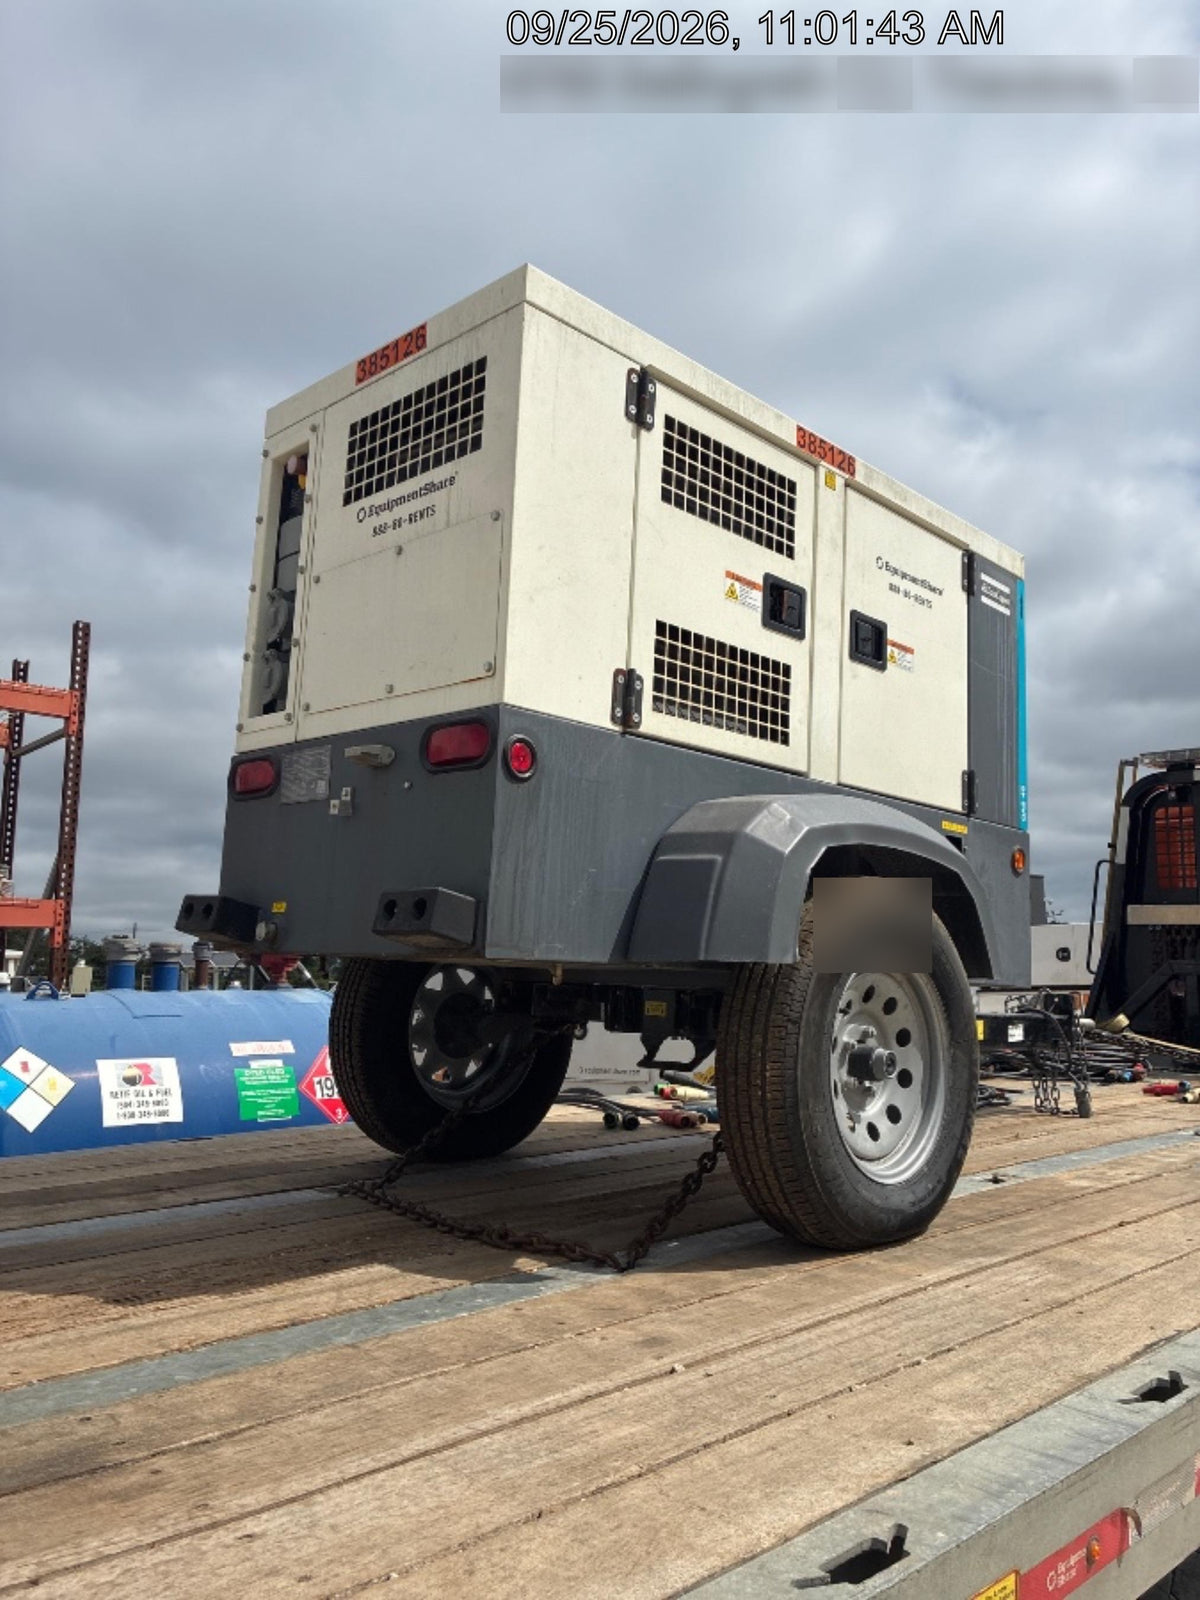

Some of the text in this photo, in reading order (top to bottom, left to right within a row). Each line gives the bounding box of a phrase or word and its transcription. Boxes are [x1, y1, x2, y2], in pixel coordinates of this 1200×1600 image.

[357, 326, 427, 383] 385126
[797, 427, 857, 477] 385126
[316, 1077, 335, 1097] 19
